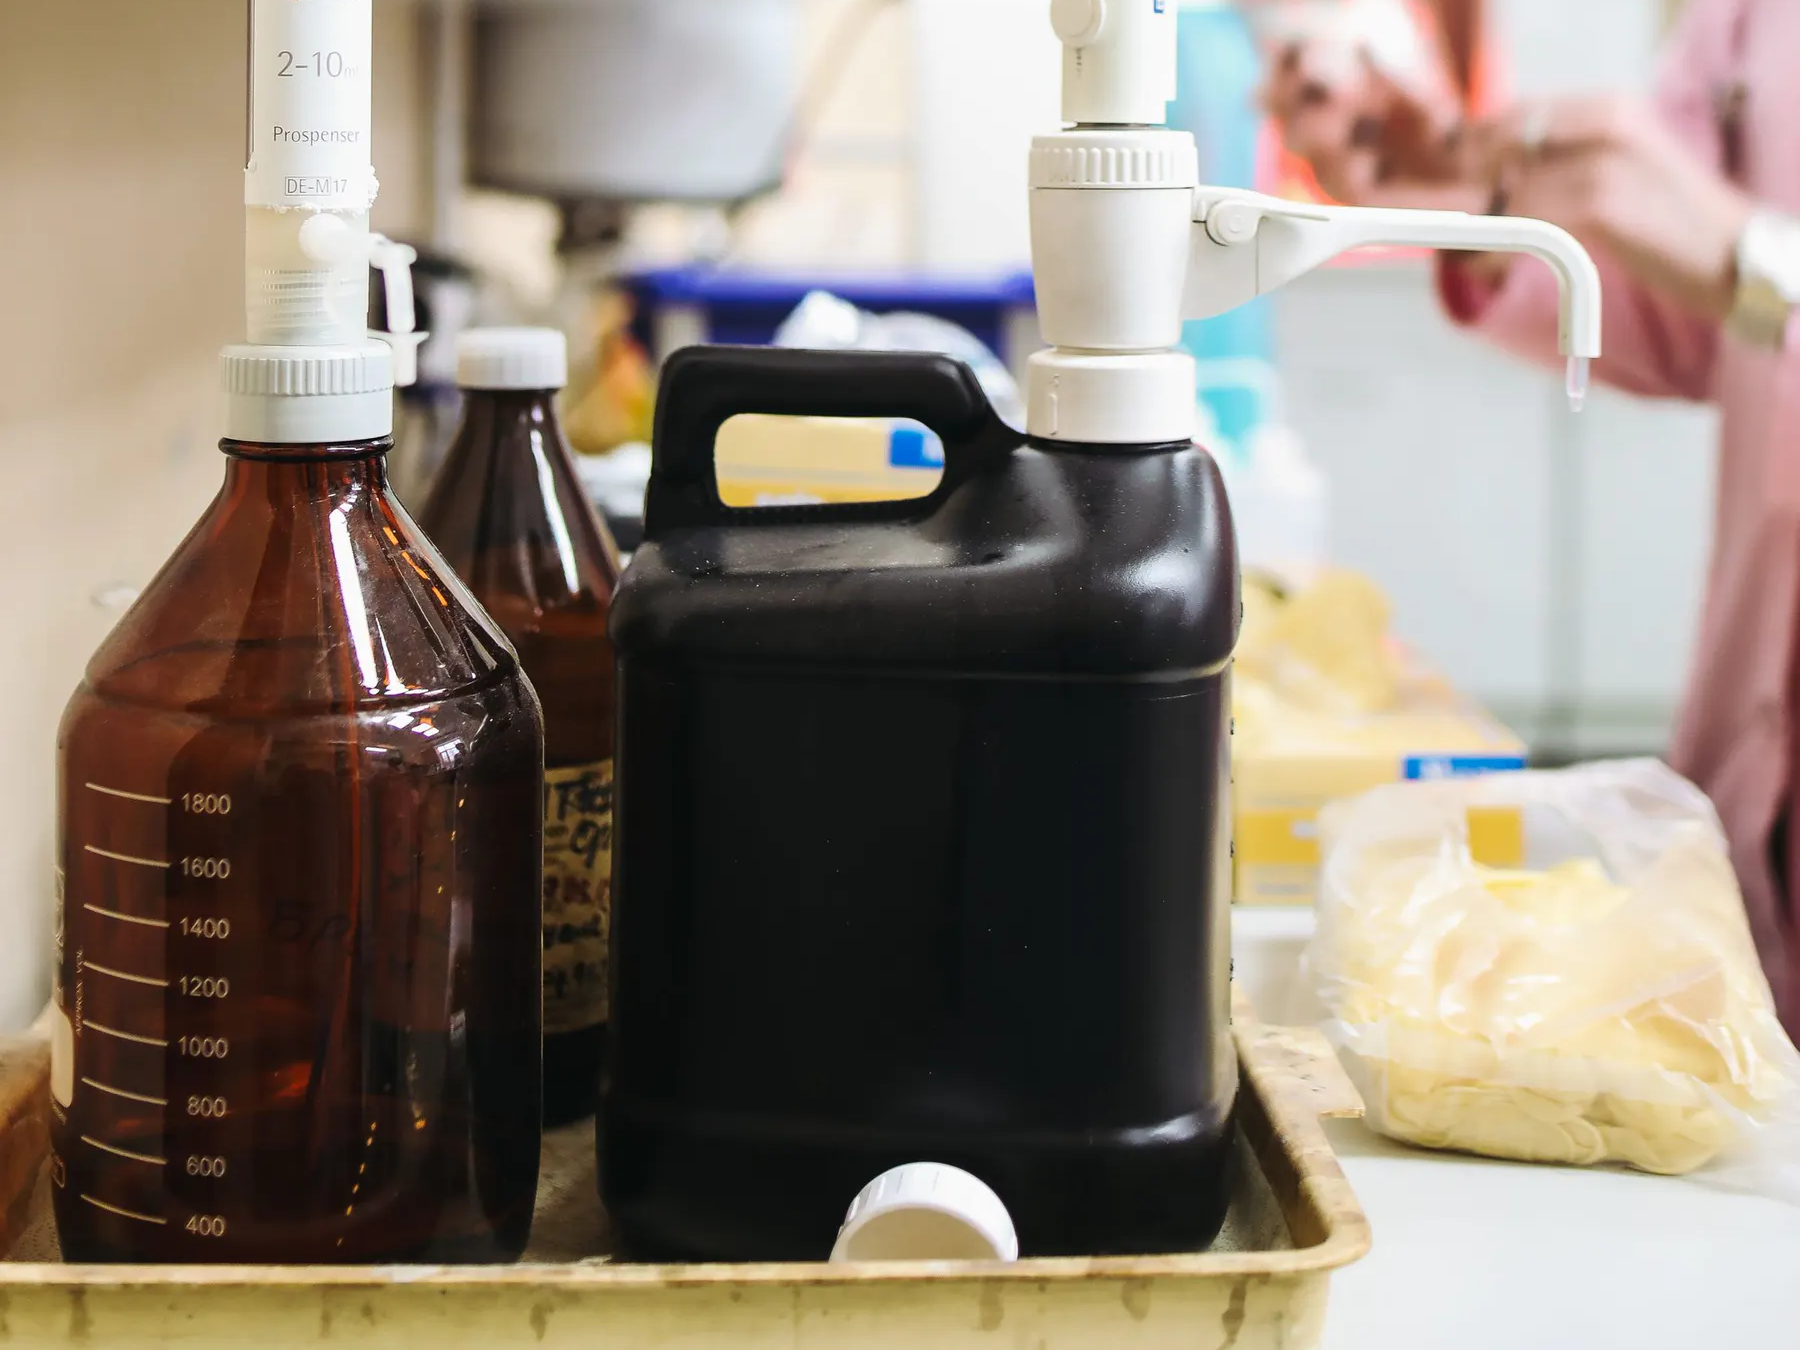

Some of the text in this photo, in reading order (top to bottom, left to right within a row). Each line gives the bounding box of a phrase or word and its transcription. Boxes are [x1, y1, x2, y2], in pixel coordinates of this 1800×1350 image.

[273, 126, 360, 146] Prospenser
[287, 178, 347, 194] DE-M 17
[182, 793, 231, 815] 1800
[181, 857, 230, 879] 1600
[180, 917, 230, 939] 1400
[180, 976, 229, 998] 1200
[179, 1036, 228, 1058] 1000
[188, 1096, 226, 1118] 800
[187, 1156, 225, 1177] 600
[186, 1216, 225, 1237] 400
